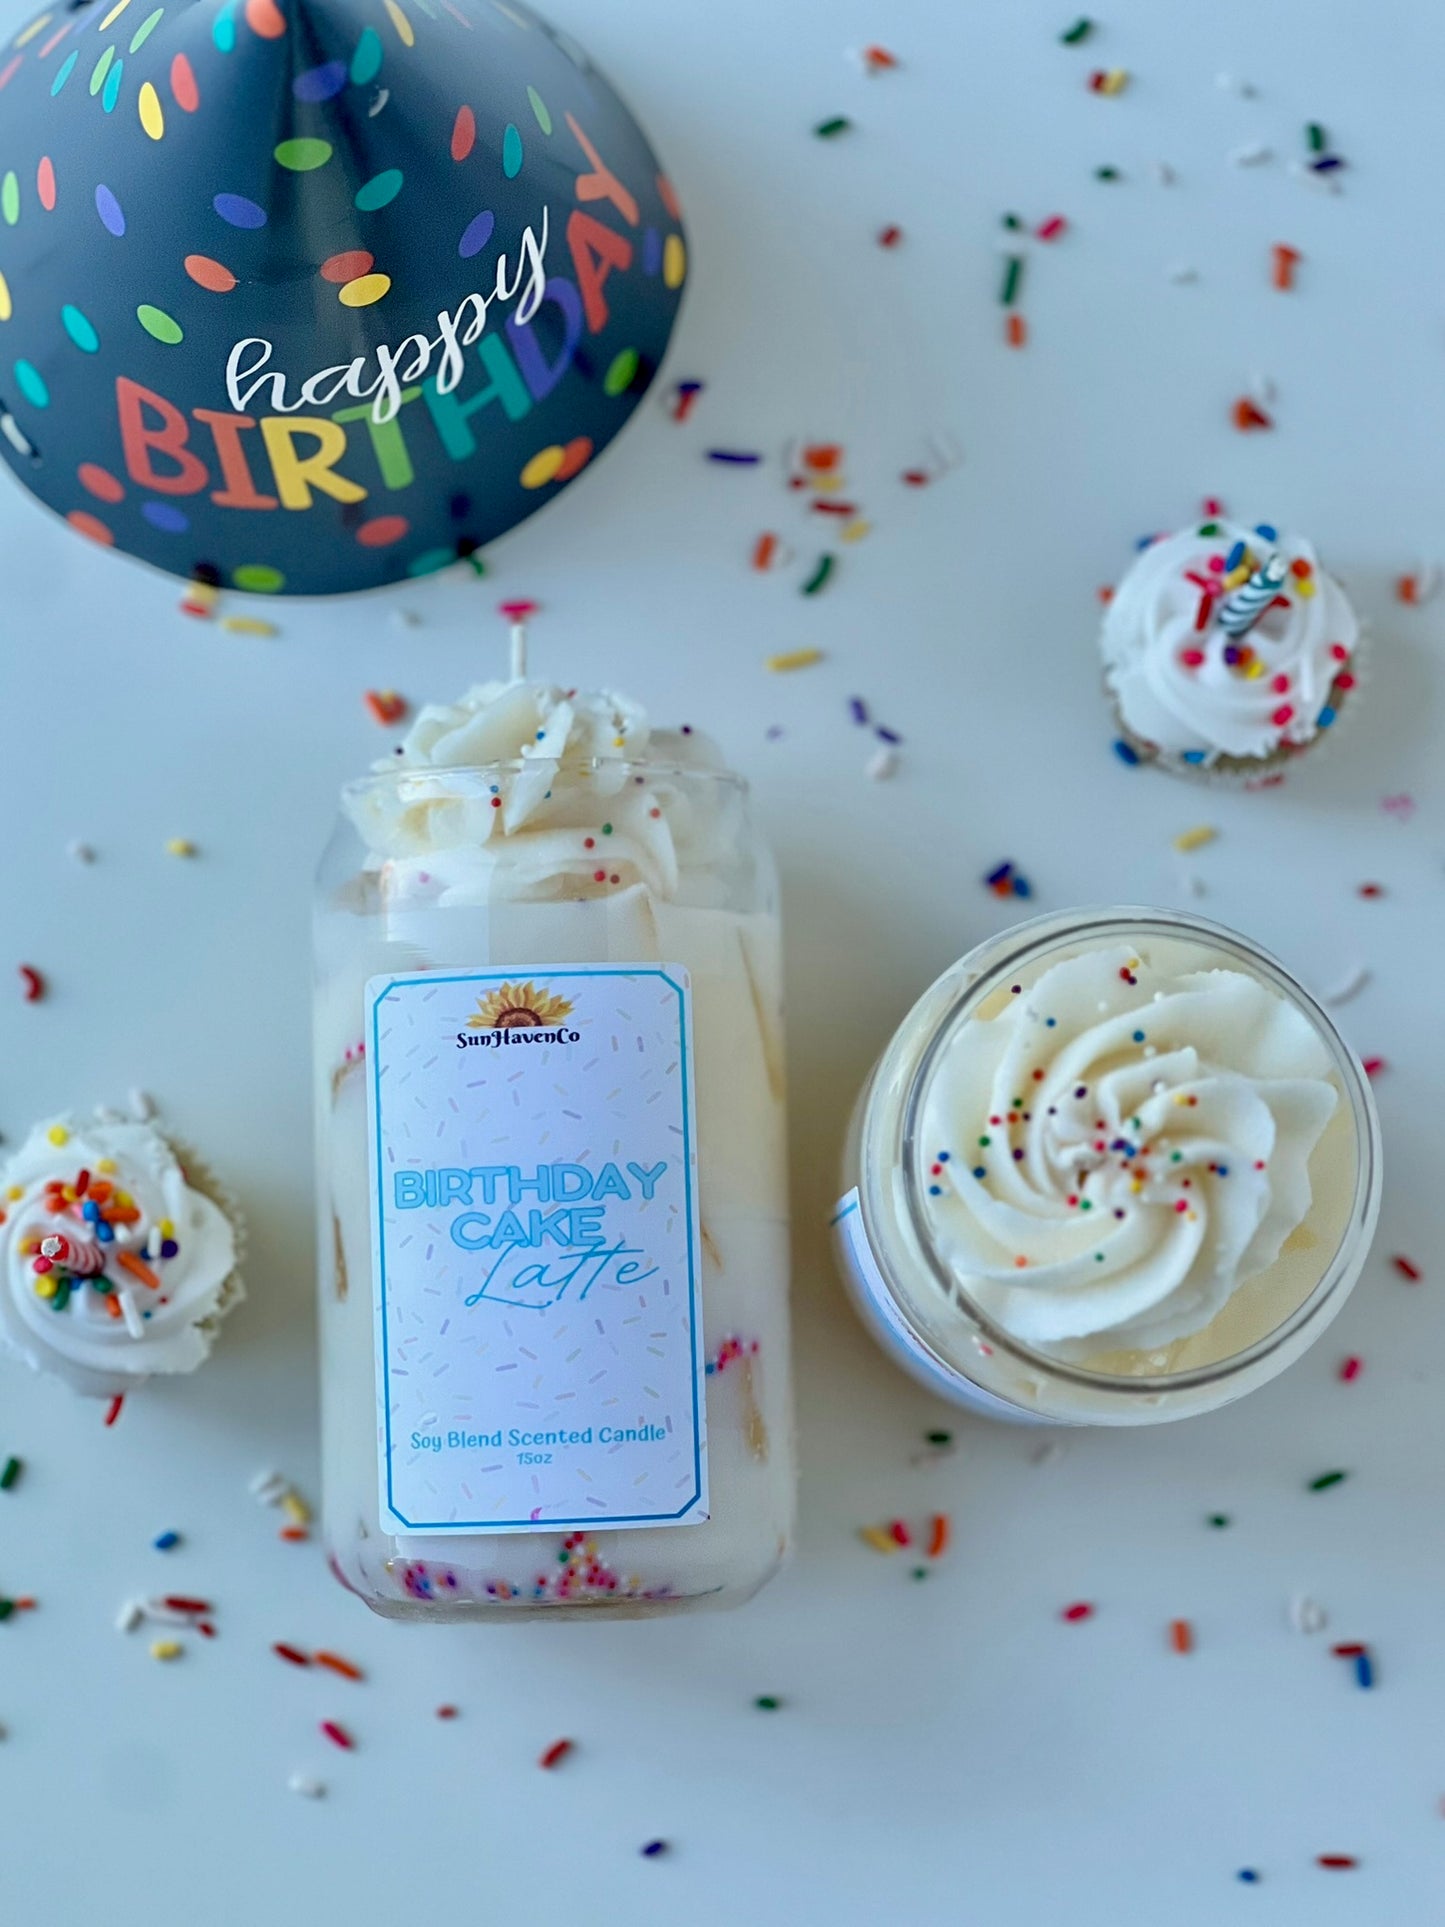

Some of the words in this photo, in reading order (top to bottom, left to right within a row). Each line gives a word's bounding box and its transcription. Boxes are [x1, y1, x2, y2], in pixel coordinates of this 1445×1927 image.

[115, 111, 640, 510] BIRTHDAY
[226, 204, 548, 424] happy
[456, 1027, 581, 1049] SunHavenCo
[393, 1161, 668, 1210] BIRTHDAY
[450, 1205, 606, 1250] CAKE
[464, 1239, 660, 1309] Latte
[410, 1432, 442, 1453] Soy
[447, 1430, 502, 1448] Blend
[508, 1426, 592, 1446] Scented
[598, 1424, 667, 1443] Candle
[516, 1452, 553, 1465] 15oz
